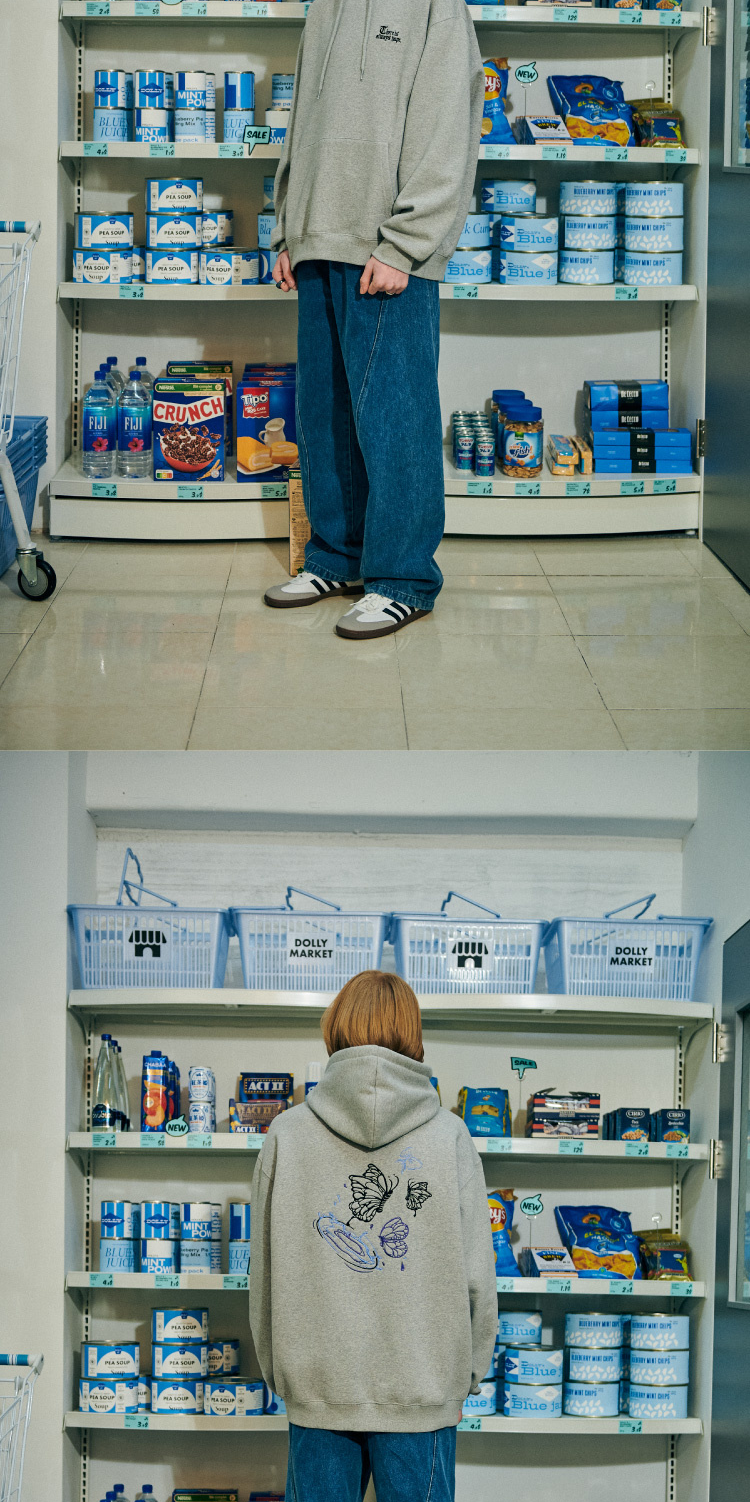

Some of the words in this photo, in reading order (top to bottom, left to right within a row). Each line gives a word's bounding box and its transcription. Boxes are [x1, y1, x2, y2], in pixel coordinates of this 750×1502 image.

[517, 69, 536, 80] NEW
[178, 91, 203, 100] MINT
[135, 128, 160, 136] MINT
[247, 130, 268, 140] SALE
[517, 233, 552, 244] Blue
[507, 266, 543, 277] Blue
[241, 393, 267, 407] Tipo
[153, 396, 224, 423] CRUNCH
[88, 416, 107, 430] FIJI
[124, 416, 143, 430] FIJI
[294, 938, 328, 948] DOLLY
[289, 948, 333, 959] MARKET
[615, 946, 648, 956] DOLLY
[610, 956, 653, 967] MARKET
[248, 1081, 270, 1091] ACT
[271, 1081, 284, 1090] II
[168, 1123, 187, 1132] NEW
[522, 1202, 541, 1211] NEW
[183, 1222, 209, 1231] MINT
[141, 1258, 166, 1266] MINT
[521, 1366, 557, 1376] Blue
[512, 1399, 548, 1410] Blue
